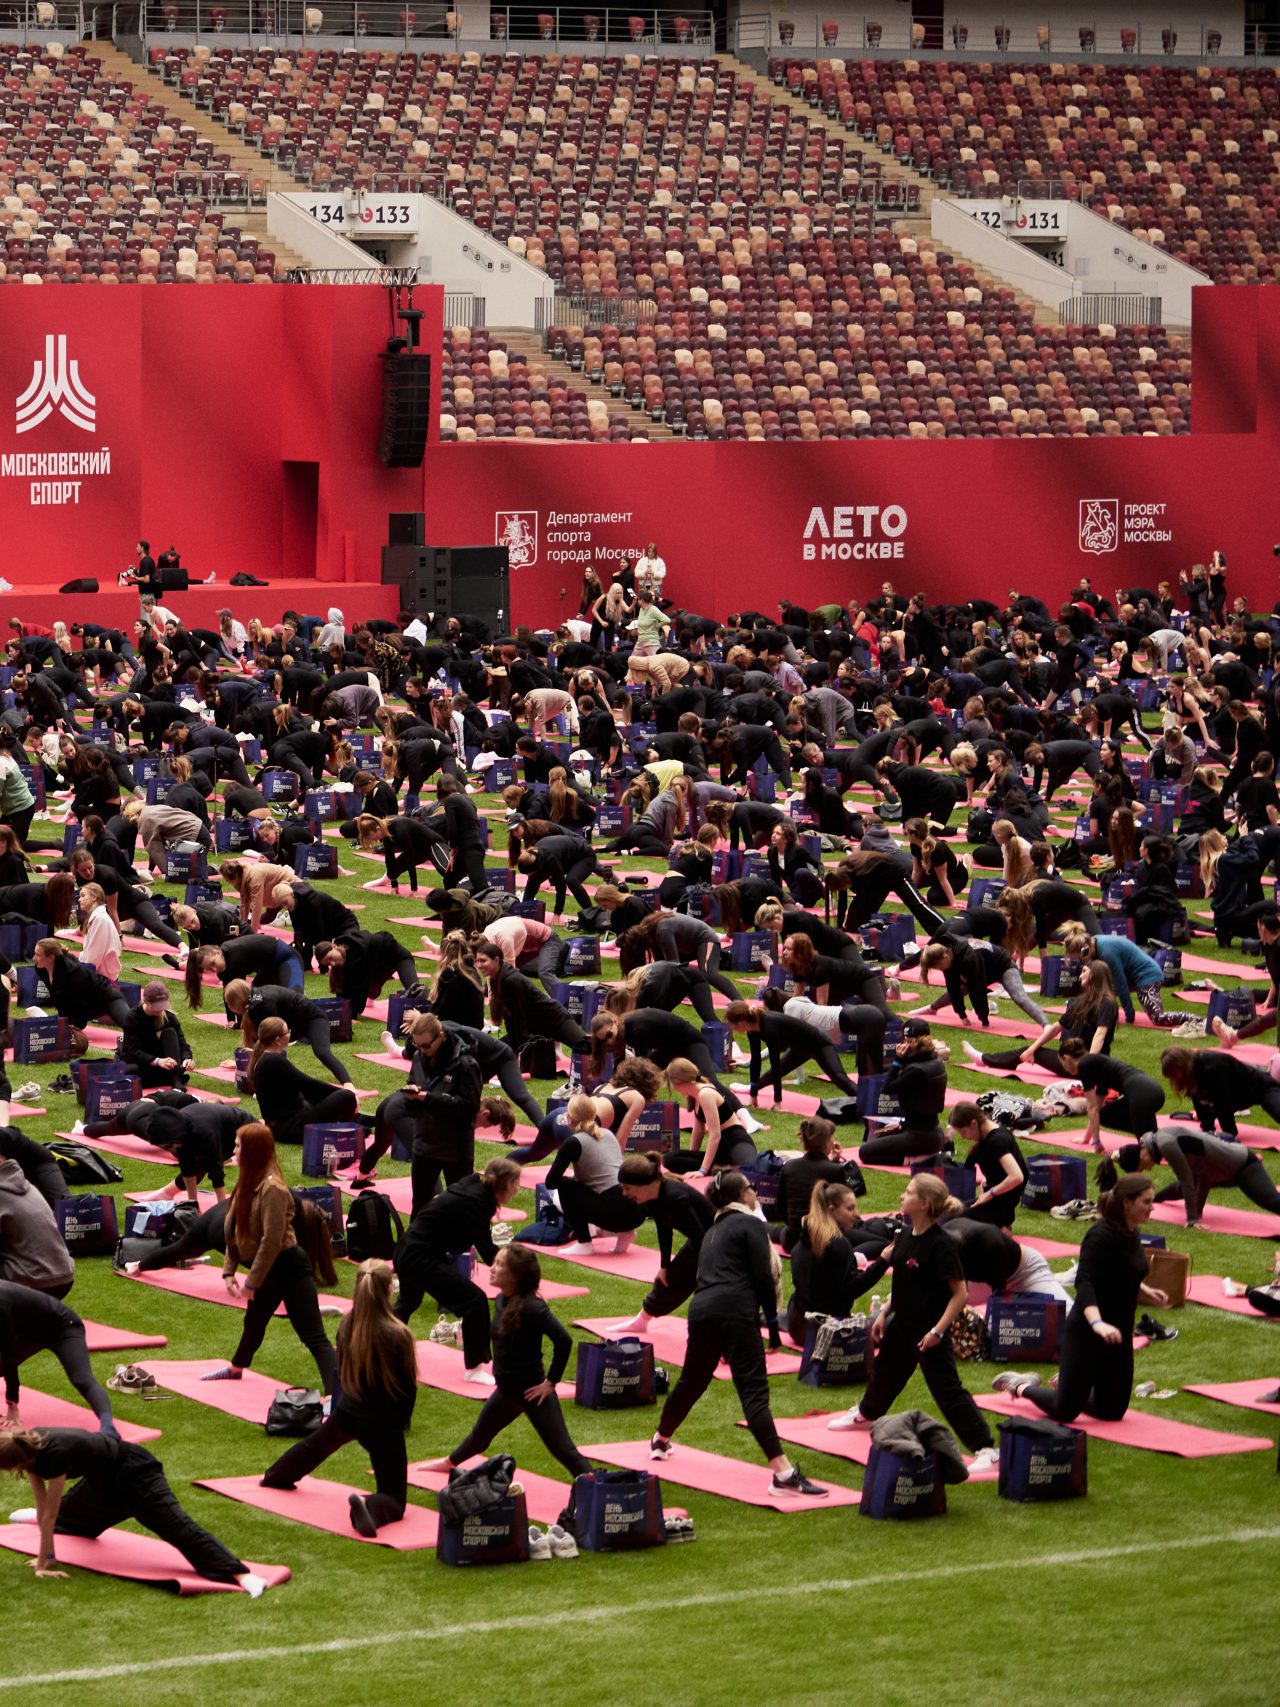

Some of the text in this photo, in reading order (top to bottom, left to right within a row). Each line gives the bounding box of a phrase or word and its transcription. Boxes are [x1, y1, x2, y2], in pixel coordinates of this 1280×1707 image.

[376, 206, 410, 223] 133
[1029, 213, 1059, 229] 131
[1, 447, 111, 477] МОСКОВСКИЙ
[30, 481, 81, 505] СПОРТ
[1124, 503, 1167, 516] ПРОЕКТ
[547, 511, 632, 527] Департамент
[803, 504, 908, 539] ЛЕТО
[1124, 517, 1155, 529] МЭРА
[547, 531, 591, 545] спорта
[1124, 530, 1172, 543] МОСКВЫ
[547, 547, 645, 564] города Москвы
[803, 542, 904, 560] В МОСКВЕ
[65, 1217, 78, 1225] ДЕНЬ
[65, 1231, 84, 1240] СПОРТА
[605, 1503, 623, 1513] ДЕНЬ
[604, 1522, 629, 1534] СПОРТА
